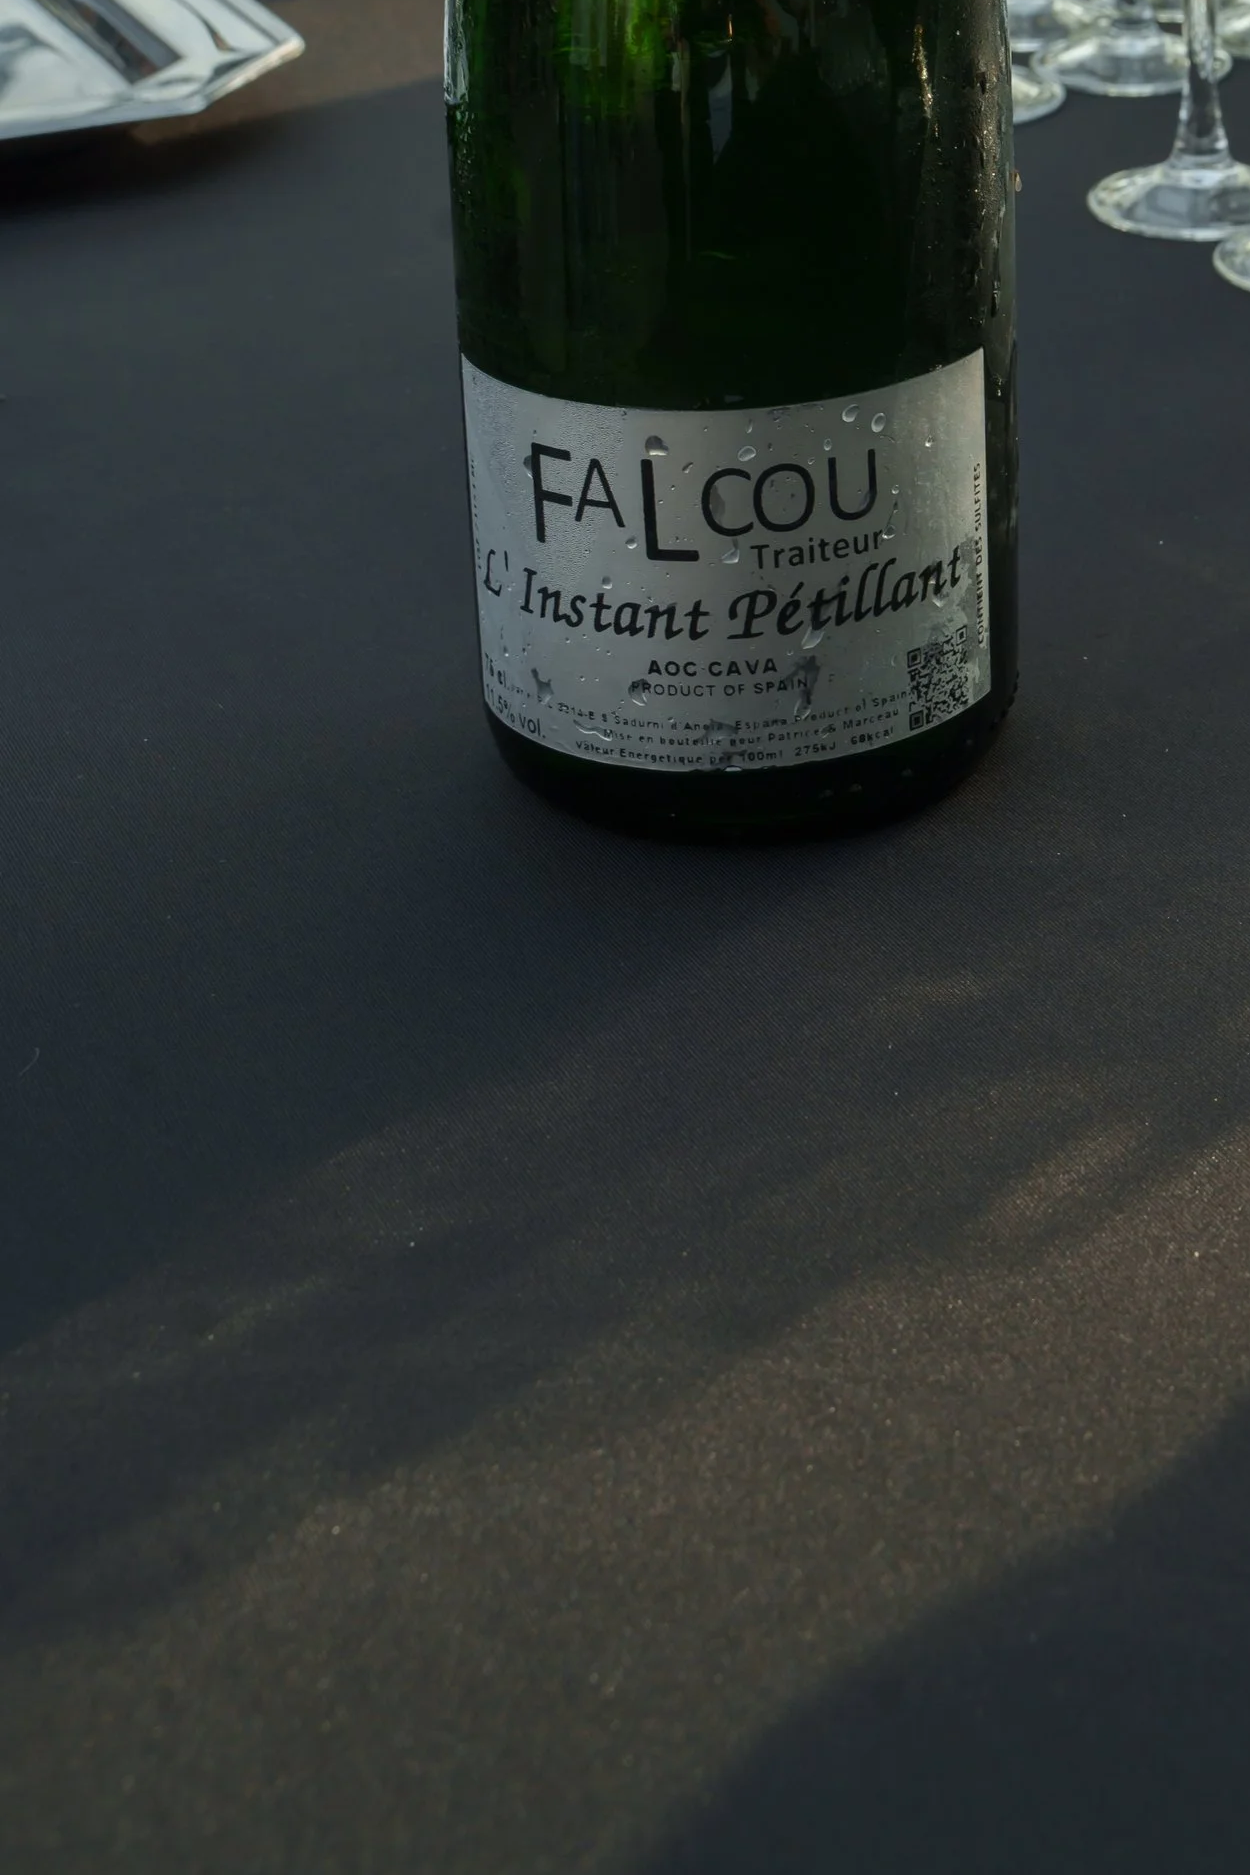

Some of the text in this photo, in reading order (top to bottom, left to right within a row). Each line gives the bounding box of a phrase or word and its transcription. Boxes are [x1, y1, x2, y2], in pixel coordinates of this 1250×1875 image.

[530, 441, 878, 562] FALCOU
[749, 527, 884, 570] Traiteur
[973, 461, 985, 645] CONTIENT DES SULFITES
[520, 566, 709, 641] Instant
[727, 545, 963, 641] Pétillant
[647, 657, 778, 677] AOC CAVA
[630, 676, 808, 698] PRODUCT OF SPAIN
[603, 729, 632, 741] Mise
[639, 734, 654, 743] en
[768, 729, 820, 743] Patrice
[843, 709, 899, 730] Marceau
[795, 742, 836, 757] 275kJ
[851, 726, 893, 745] 68kcal
